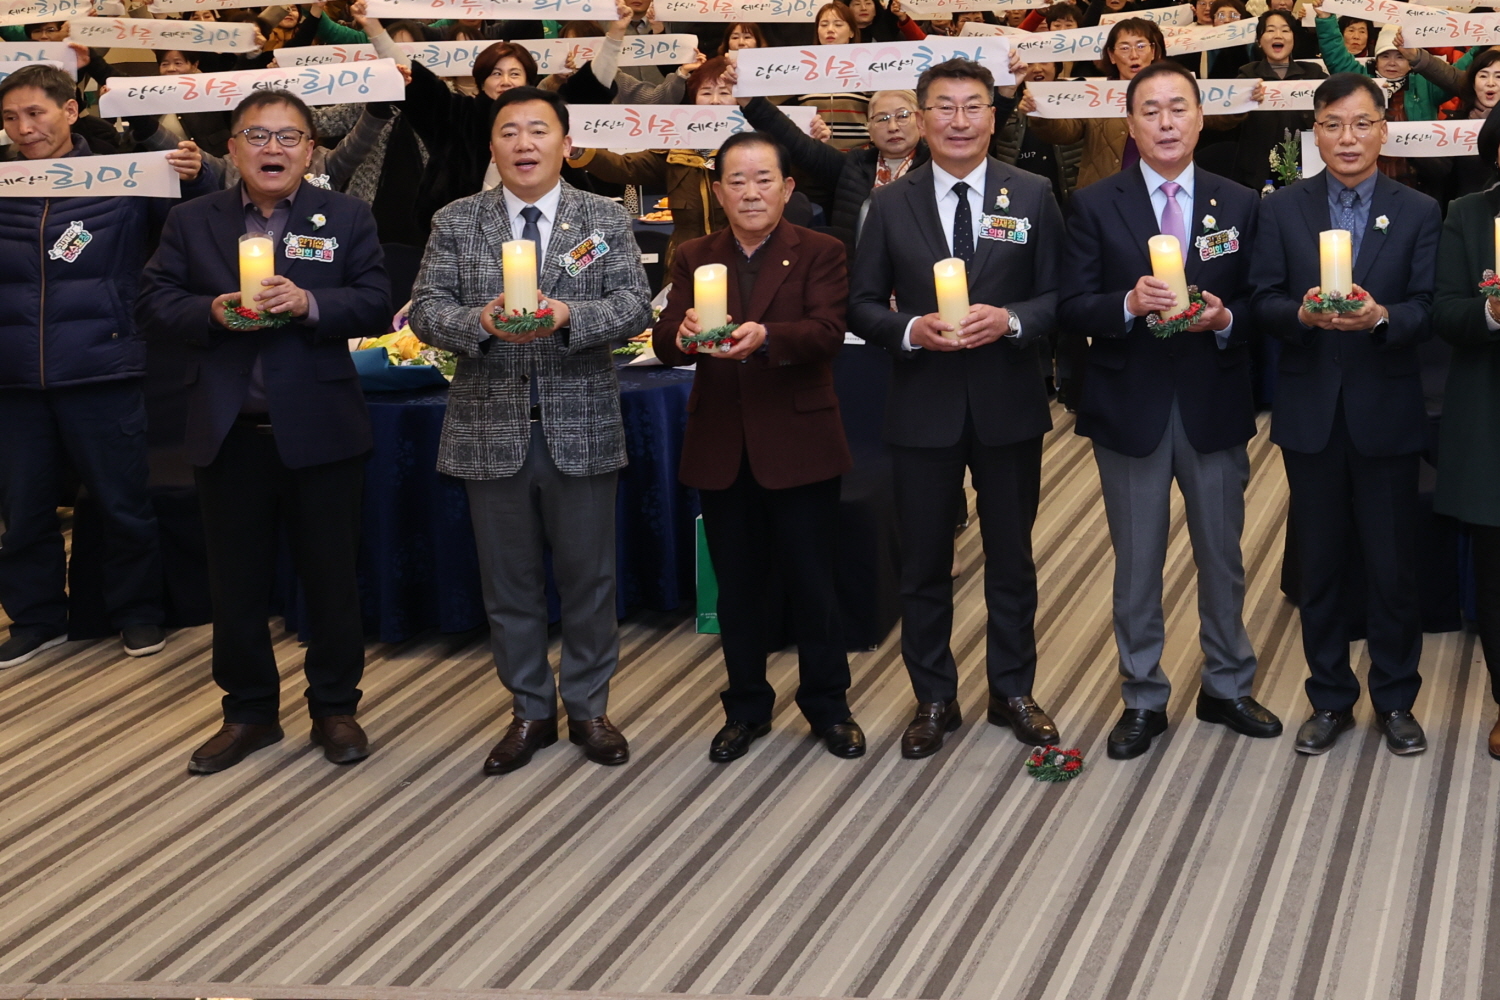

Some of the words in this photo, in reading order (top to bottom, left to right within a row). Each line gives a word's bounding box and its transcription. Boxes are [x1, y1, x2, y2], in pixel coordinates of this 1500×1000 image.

[8, 6, 37, 16] 세상의
[666, 2, 696, 11] 당신의
[741, 3, 771, 11] 세상의
[80, 26, 114, 36] 당신의
[190, 24, 241, 47] 희망
[1415, 27, 1446, 37] 당신의
[1446, 16, 1490, 43] 하루,
[632, 38, 682, 59] 희망
[1017, 40, 1052, 50] 세상의
[1050, 34, 1108, 54] 희망
[755, 63, 800, 80] 당신의
[799, 49, 861, 89] 하루,
[867, 58, 914, 73] 세상의
[128, 85, 177, 100] 당신의
[252, 78, 300, 92] 세상의
[299, 67, 376, 95] 희망
[1047, 92, 1085, 106] 당신의
[583, 119, 625, 134] 당신의
[625, 108, 681, 145] 하루,
[686, 122, 728, 133] 세상의
[1395, 133, 1432, 145] 당신의
[46, 162, 144, 190] 희망
[1007, 231, 1026, 242] 의원
[287, 247, 313, 258] 군의회
[315, 250, 334, 261] 의원
[591, 242, 609, 258] 의원
[1201, 245, 1223, 259] 군의회
[1222, 240, 1239, 252] 의장
